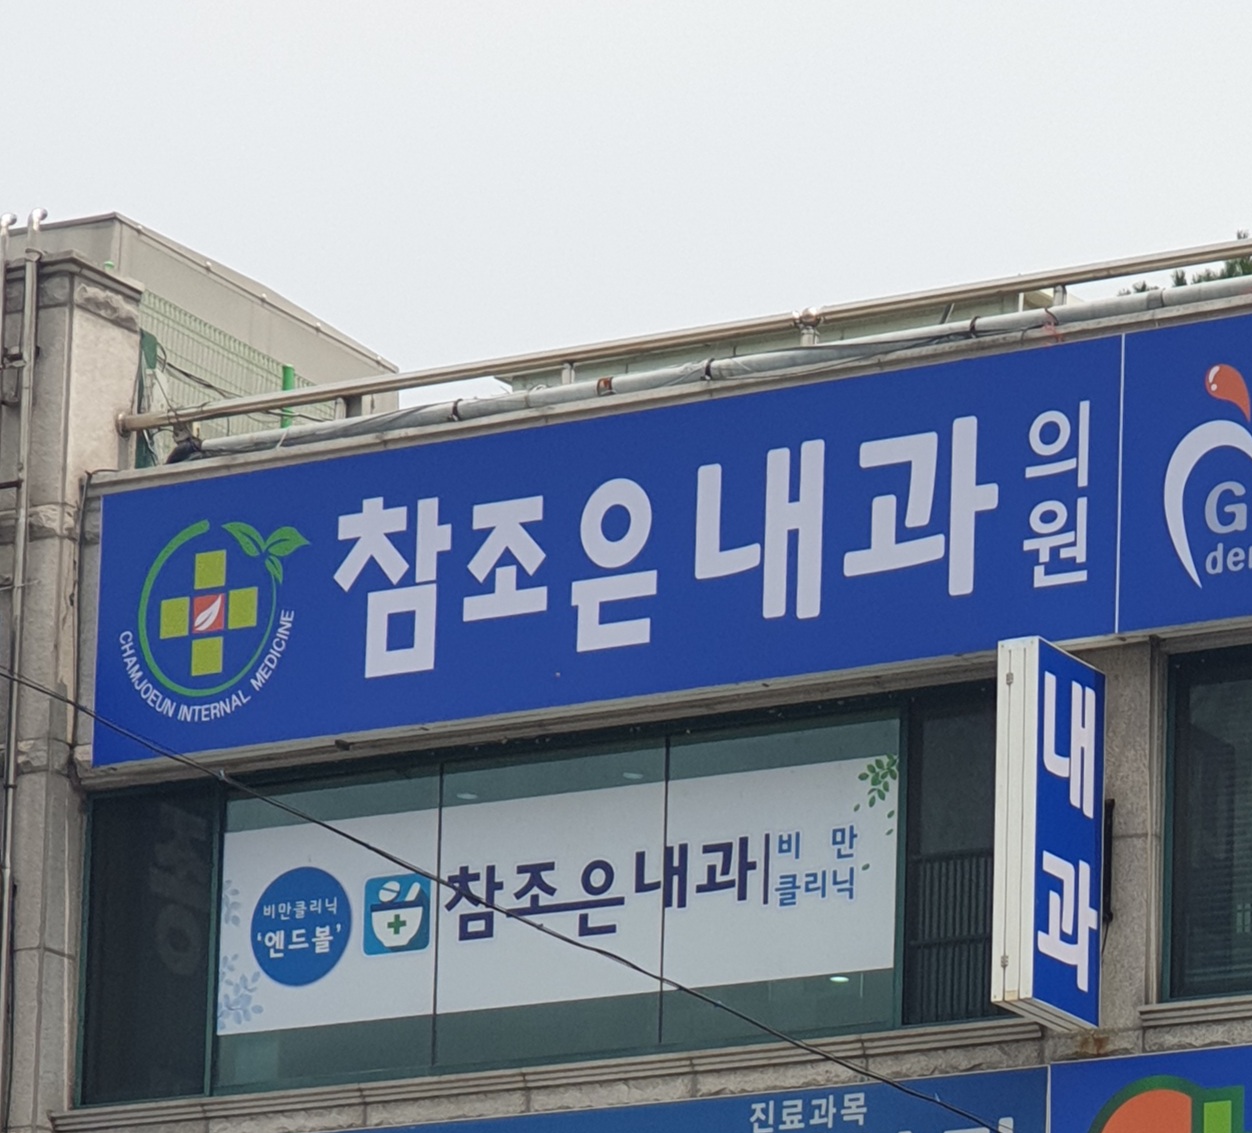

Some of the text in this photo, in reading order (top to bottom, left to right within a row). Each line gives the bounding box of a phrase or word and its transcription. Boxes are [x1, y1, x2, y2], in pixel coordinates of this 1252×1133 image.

[333, 400, 1091, 678] 참조은내과 의원
[119, 609, 294, 722] CHAMJOEUN INTERNAL MEDICINE
[775, 866, 856, 907] 클리닉
[1036, 670, 1099, 994] 내과
[263, 897, 338, 921] 비만클리닉
[444, 835, 758, 943] 참조은내과
